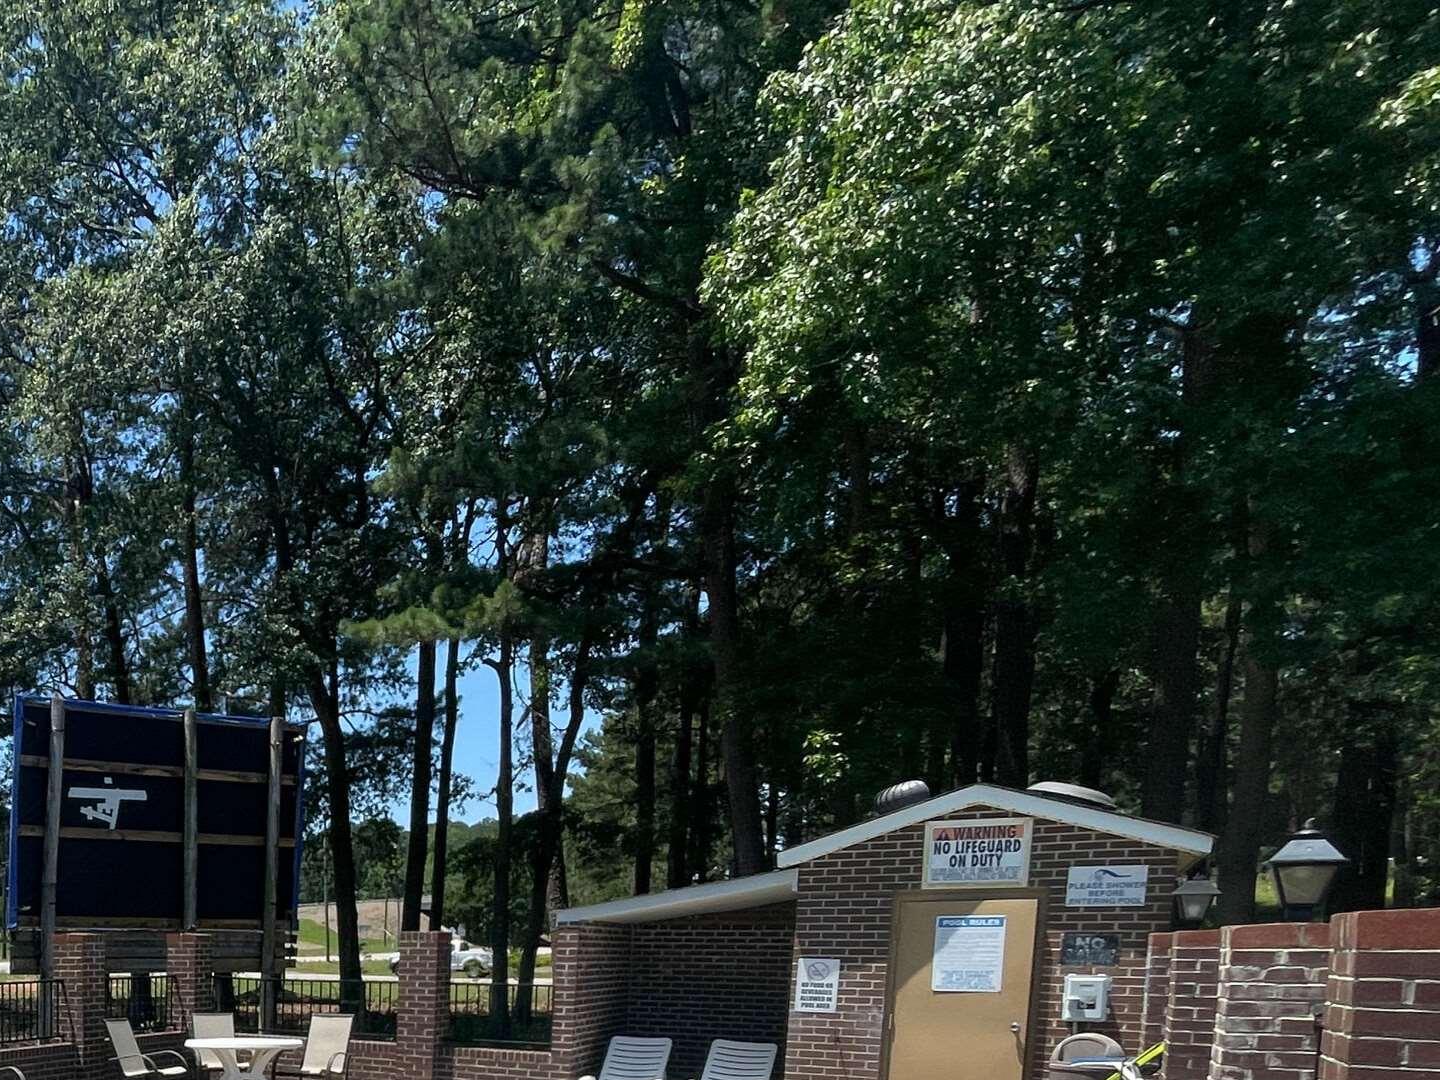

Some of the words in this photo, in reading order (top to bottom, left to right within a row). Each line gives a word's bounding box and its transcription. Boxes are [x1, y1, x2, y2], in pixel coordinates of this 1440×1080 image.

[954, 825, 1016, 840] WARNING
[934, 841, 951, 855] NO
[955, 839, 1021, 854] LIFEGUARD
[949, 855, 966, 868] ON
[971, 853, 1003, 867] DUTY
[1069, 882, 1104, 890] PLEASE
[1106, 881, 1146, 889] SHOWER
[1088, 889, 1125, 897] BEFORE
[942, 919, 967, 927] POOL
[1075, 937, 1105, 949] NO
